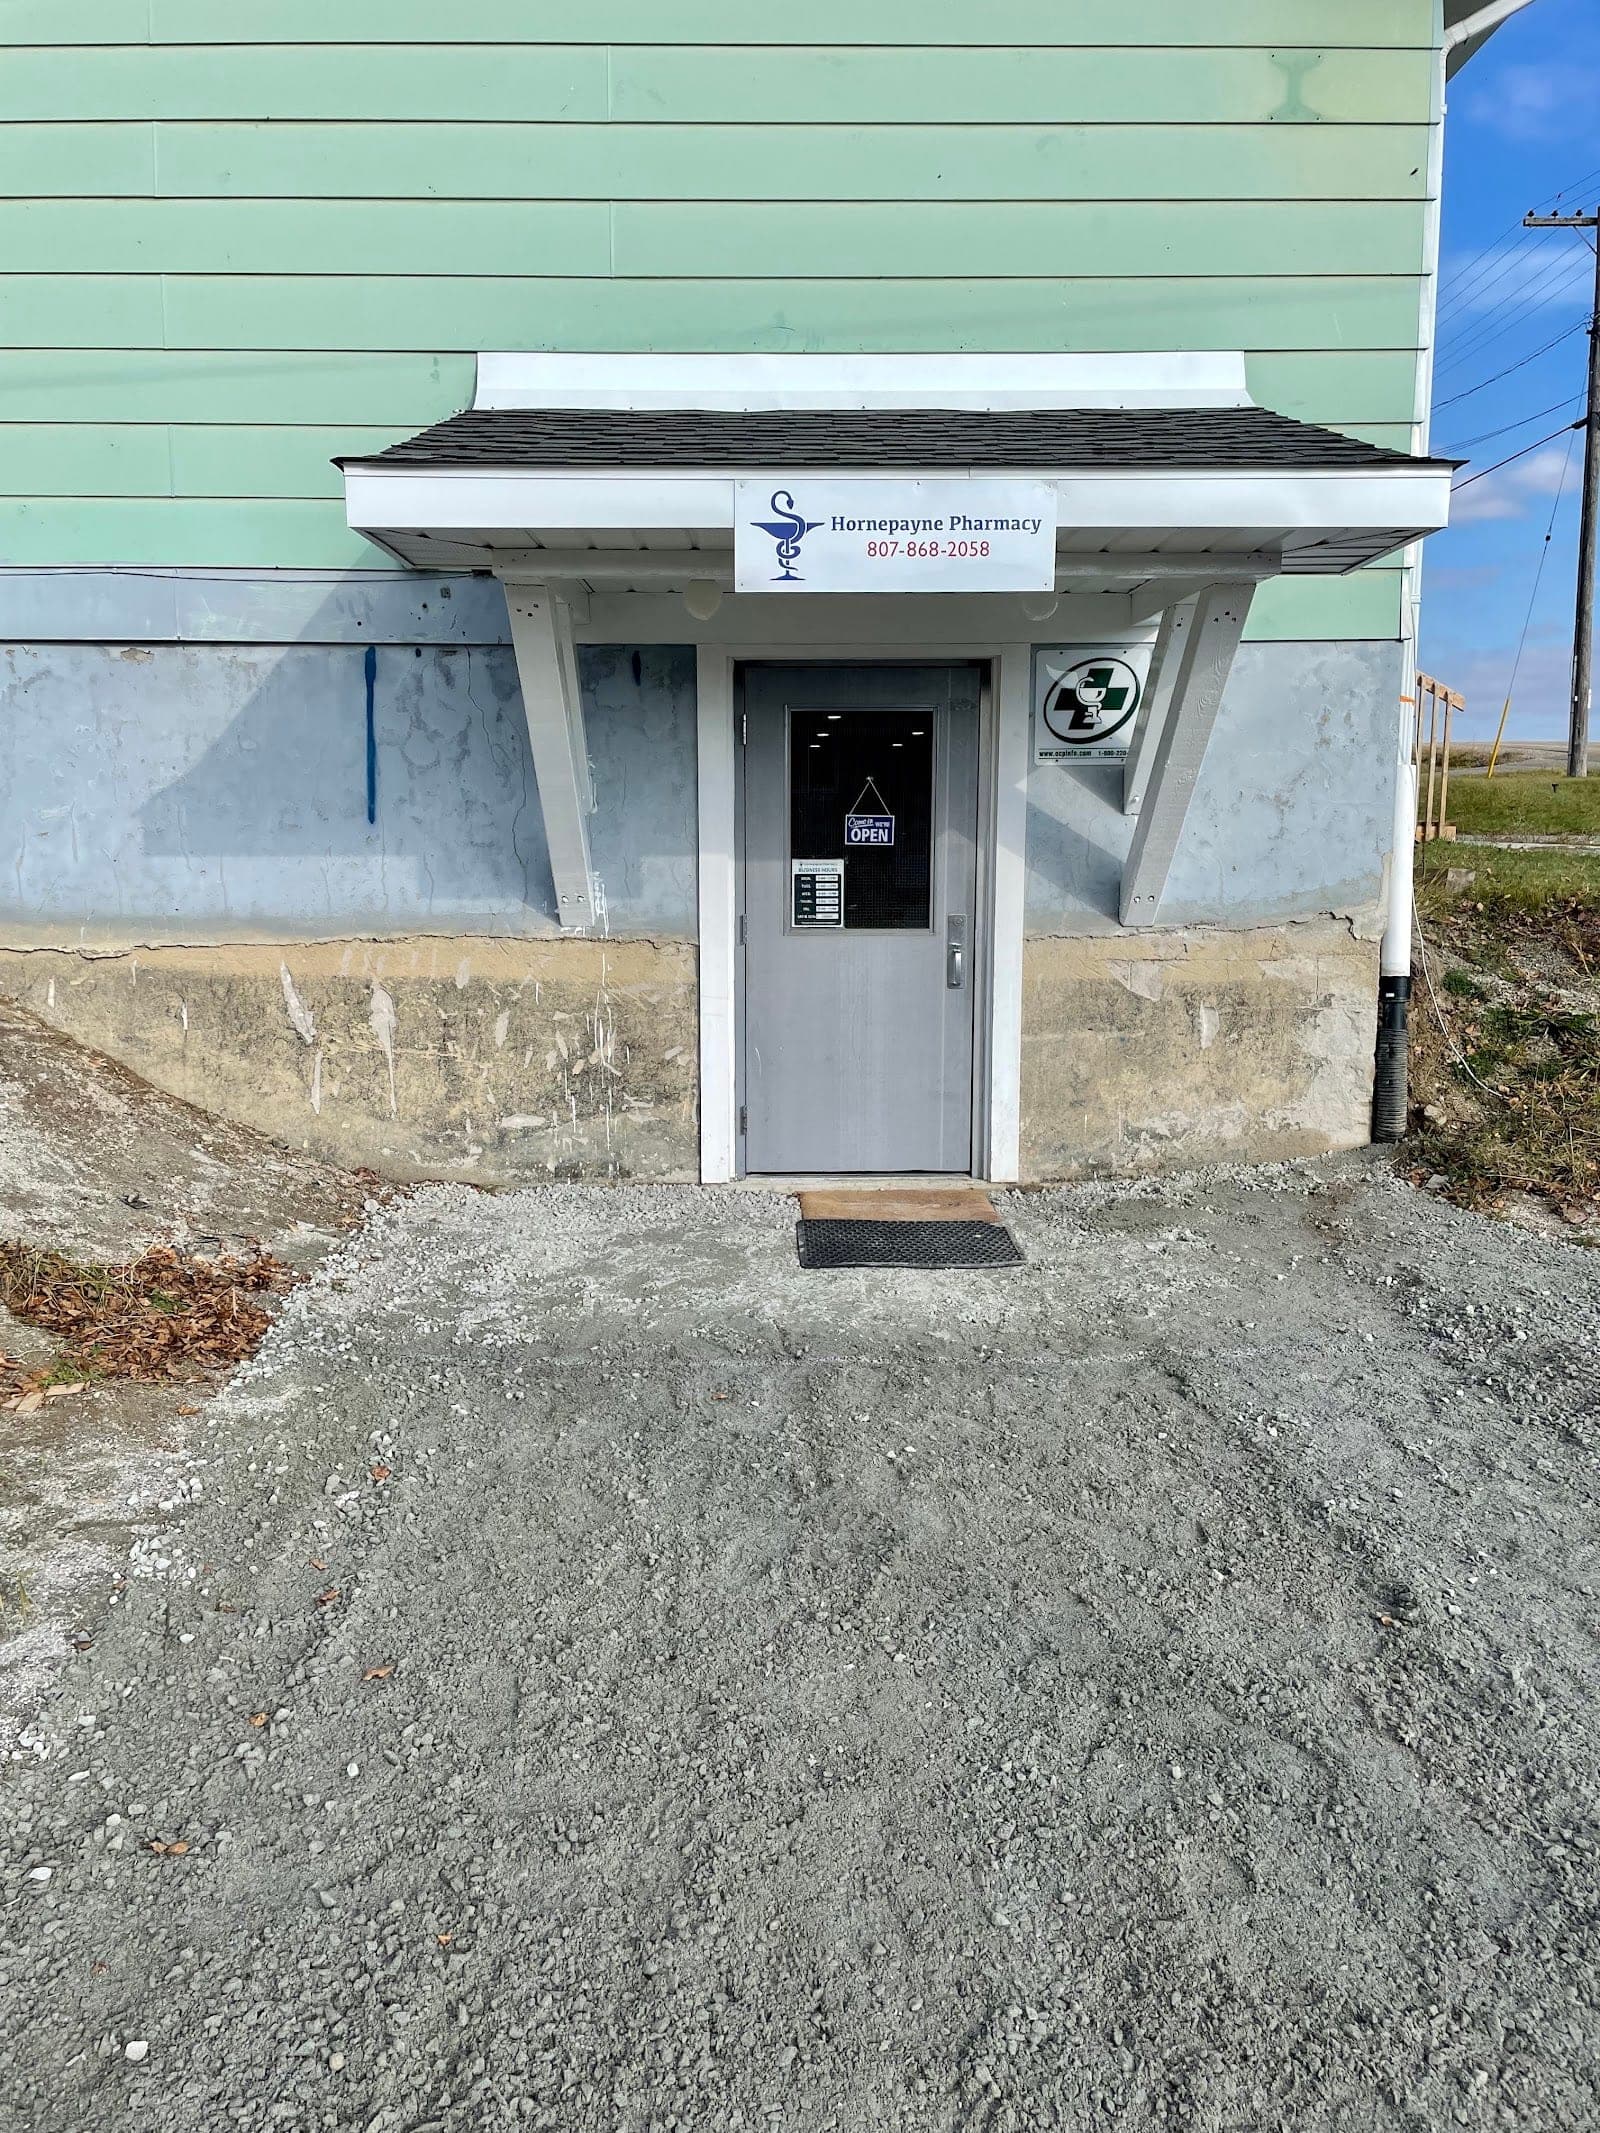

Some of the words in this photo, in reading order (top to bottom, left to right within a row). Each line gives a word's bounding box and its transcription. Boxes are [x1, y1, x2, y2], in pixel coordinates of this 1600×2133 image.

[831, 515, 944, 535] Hornepayne
[949, 515, 1042, 534] Pharmacy
[867, 541, 990, 557] 807-868-2058
[850, 828, 889, 842] OPEN
